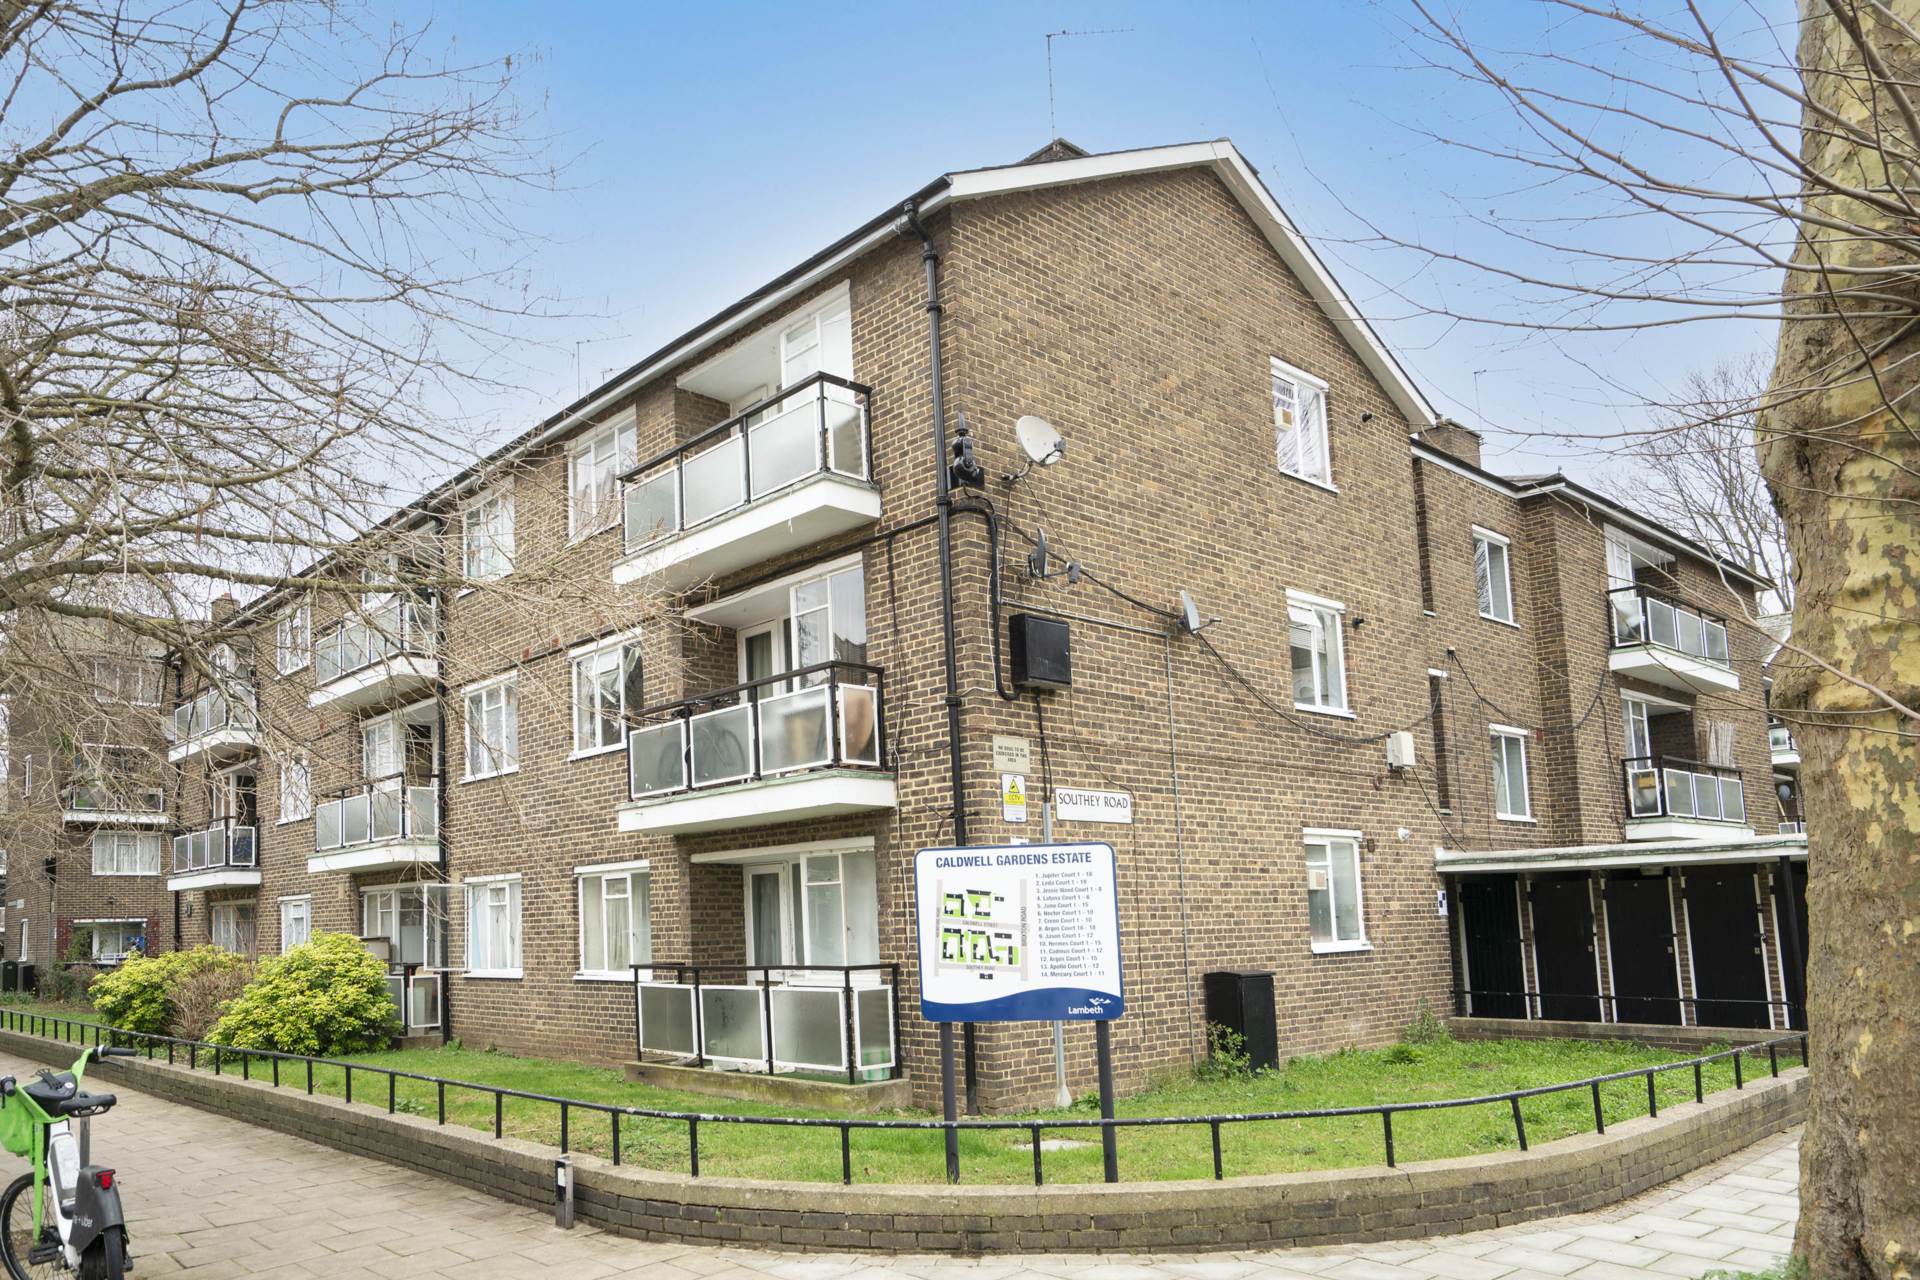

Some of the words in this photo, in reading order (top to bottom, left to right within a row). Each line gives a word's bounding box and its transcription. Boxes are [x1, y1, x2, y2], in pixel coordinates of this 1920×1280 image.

[1058, 792, 1100, 807] SOUTHEY
[1104, 796, 1128, 808] ROAD
[936, 856, 993, 868] CALDWELL
[996, 853, 1048, 866] GARDENS
[1052, 852, 1092, 864] ESTATE
[1068, 1006, 1103, 1014] Lambeth
